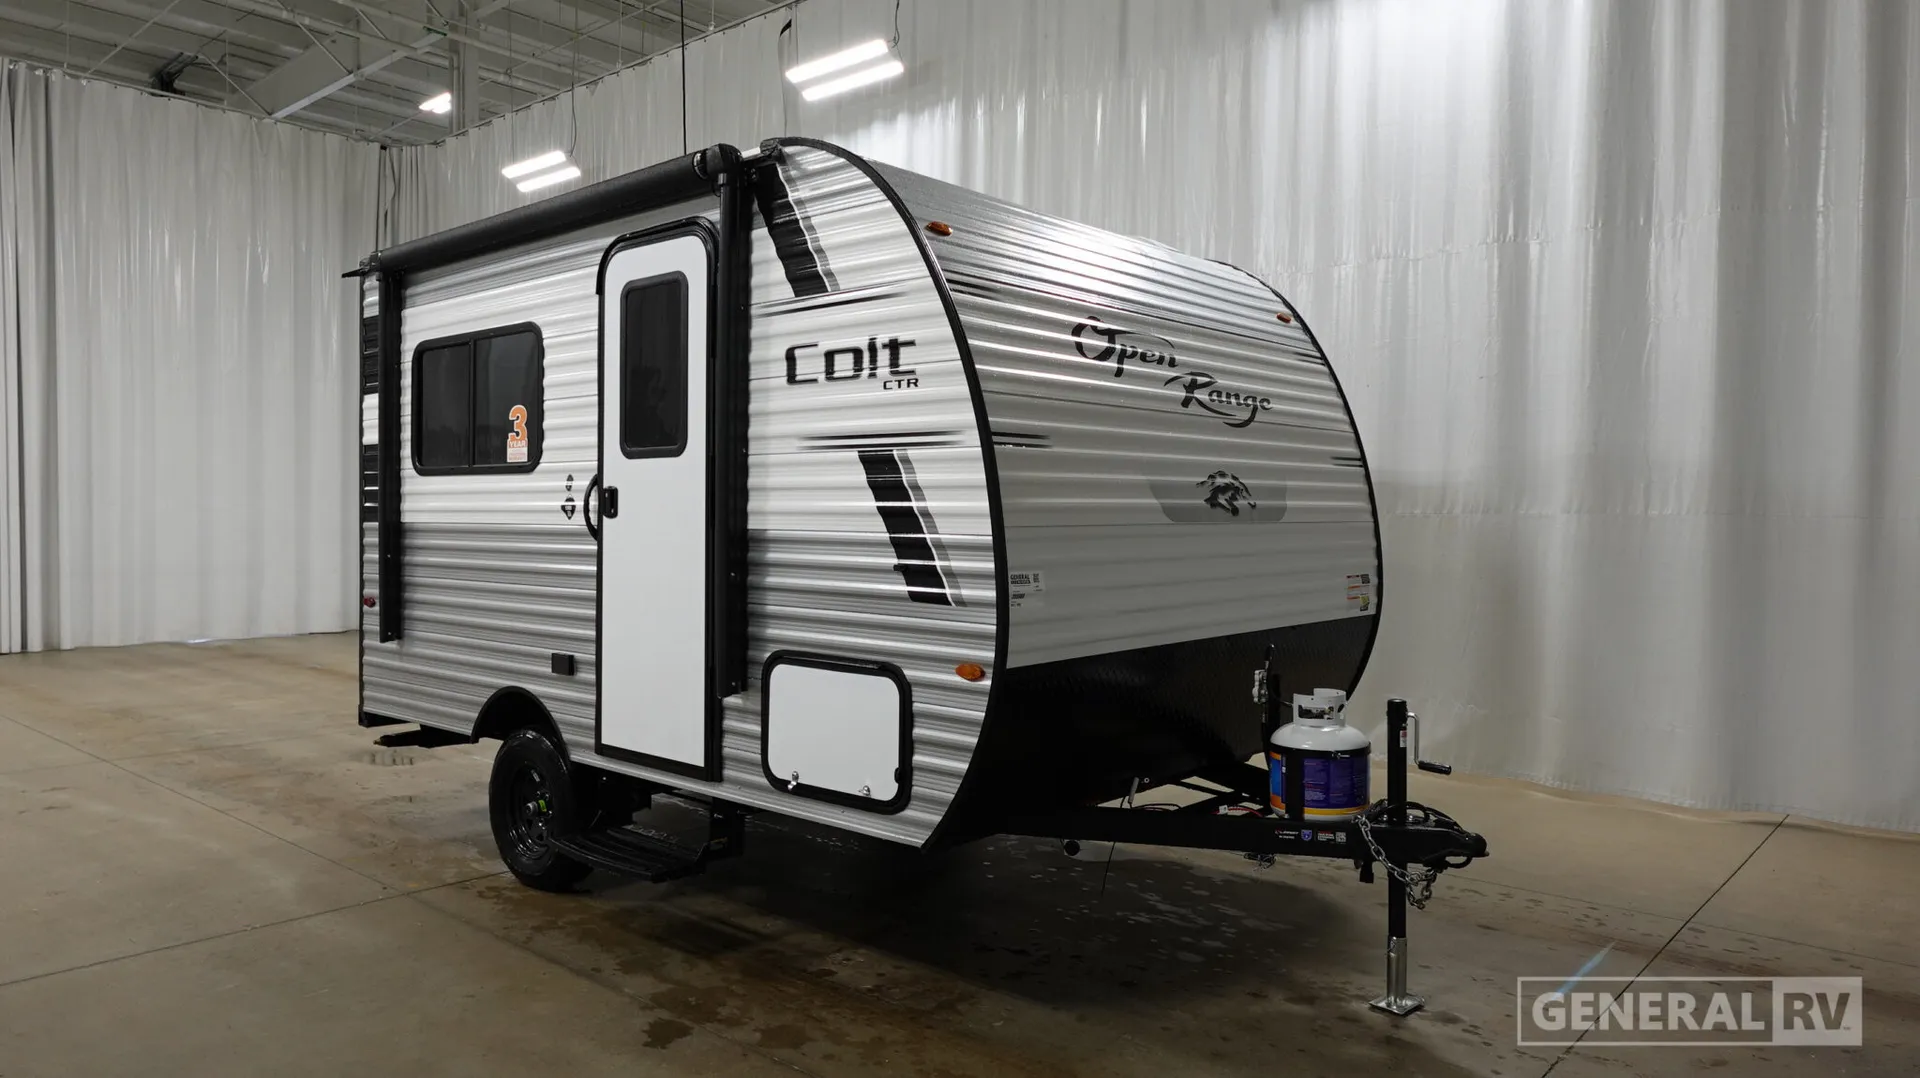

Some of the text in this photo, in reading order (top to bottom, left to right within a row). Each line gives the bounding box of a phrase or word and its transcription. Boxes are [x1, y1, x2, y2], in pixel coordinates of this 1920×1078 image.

[785, 335, 916, 385] Colt
[1071, 315, 1178, 378] Open
[882, 377, 919, 390] CTR
[1164, 371, 1273, 428] Range
[508, 405, 528, 441] 3
[509, 440, 527, 448] YEAR
